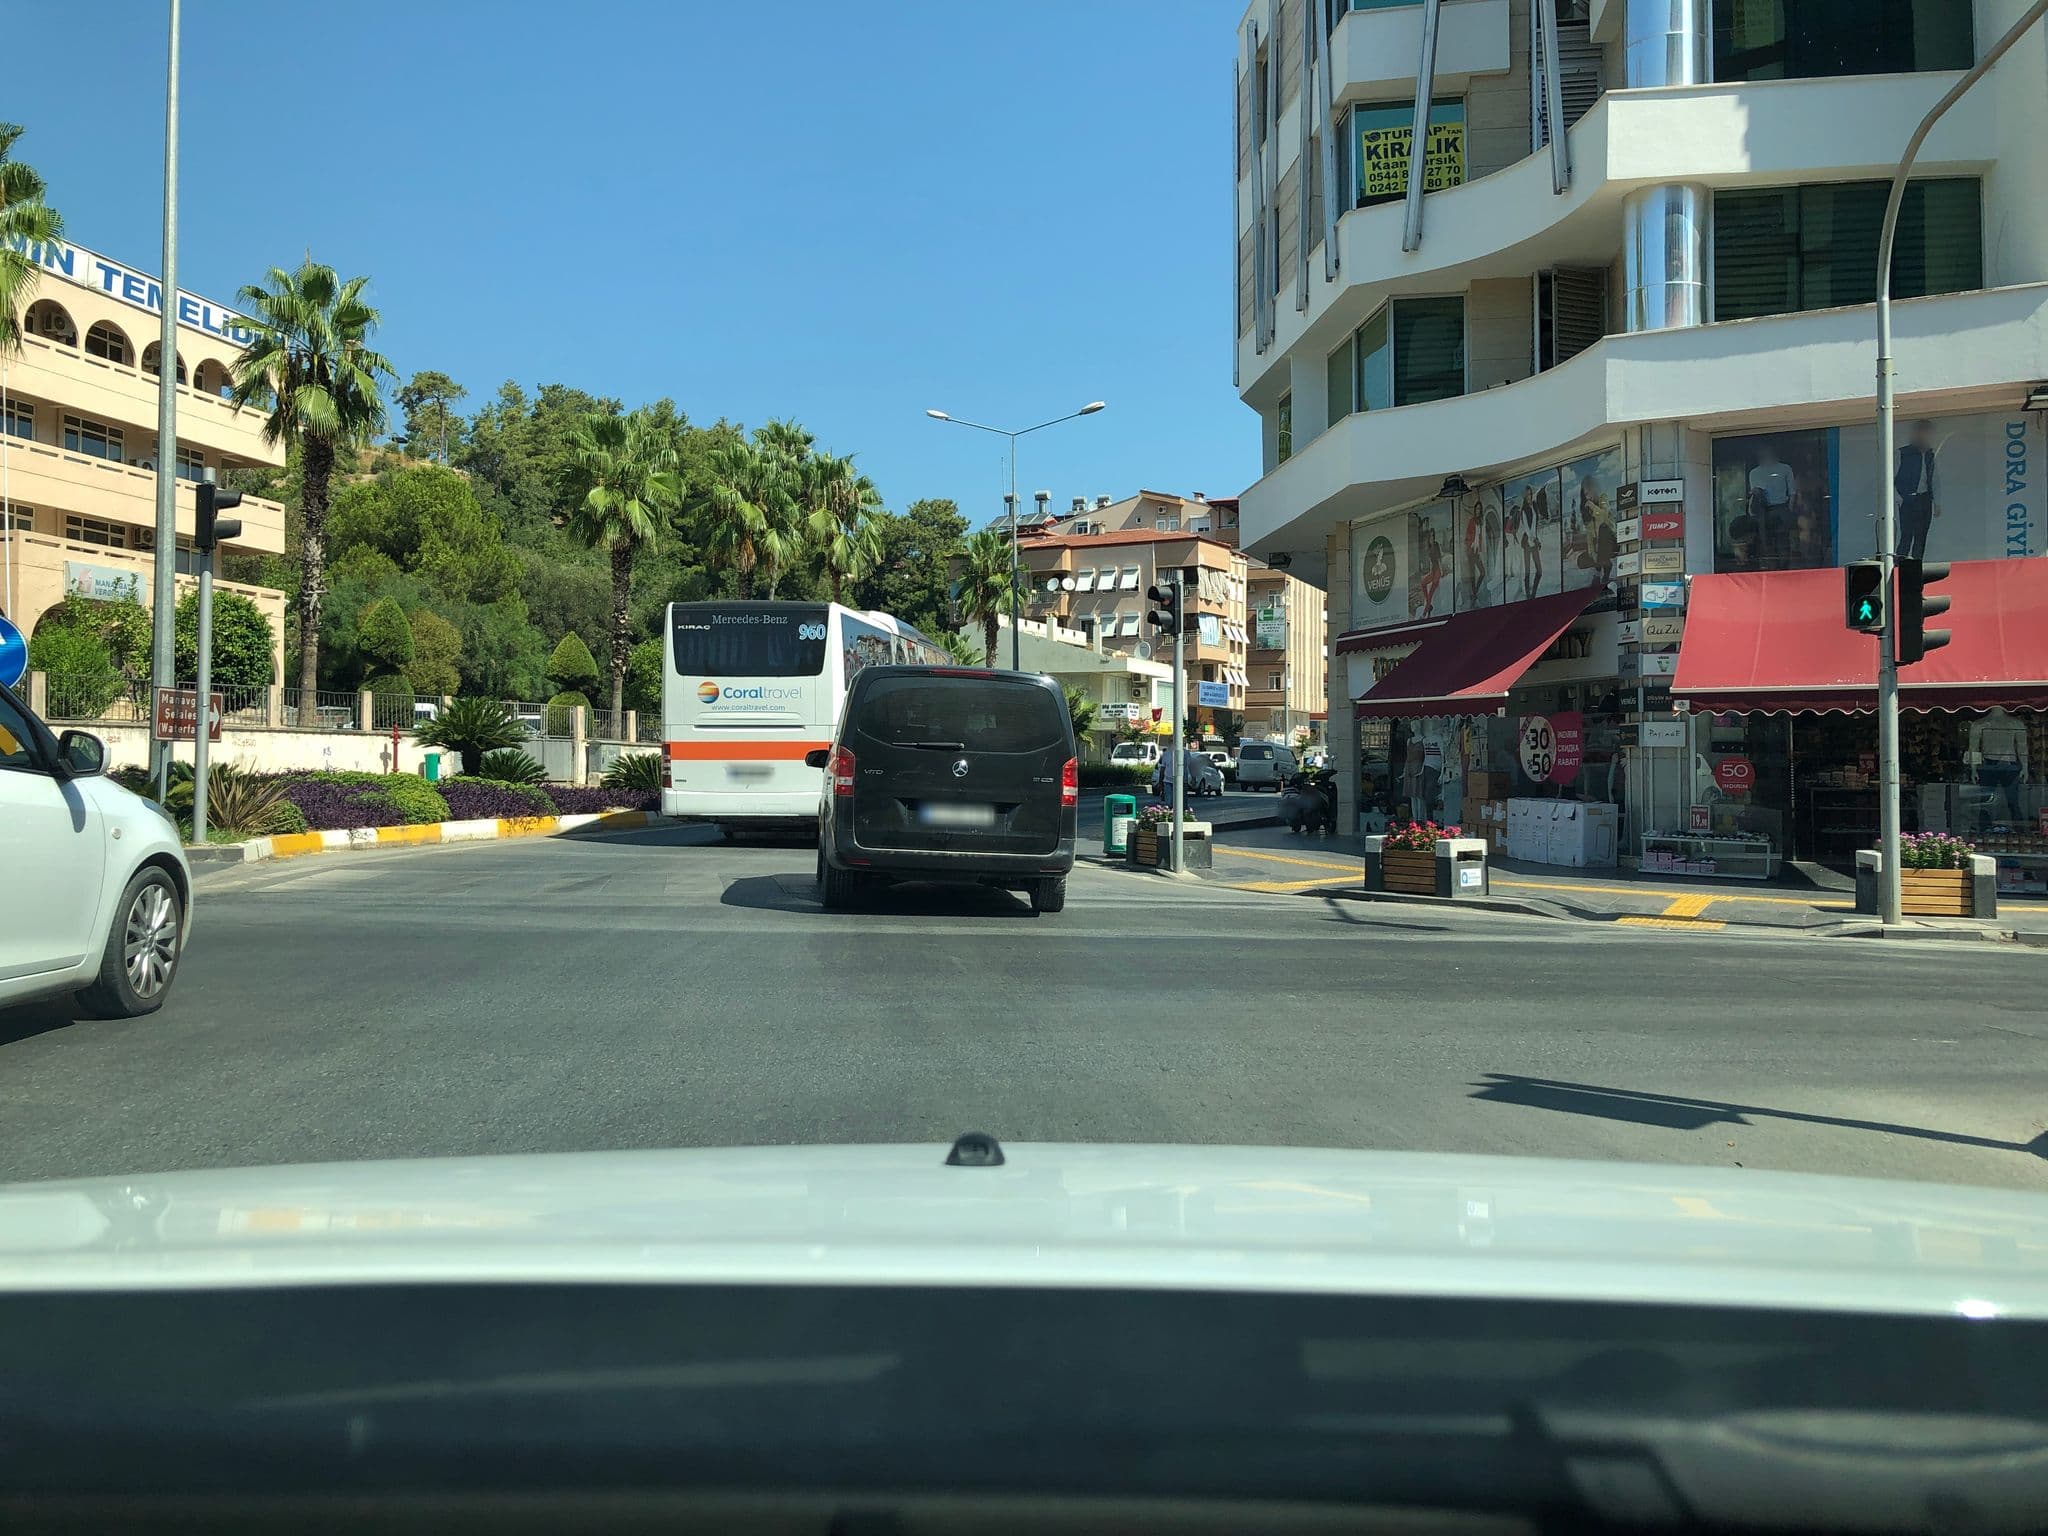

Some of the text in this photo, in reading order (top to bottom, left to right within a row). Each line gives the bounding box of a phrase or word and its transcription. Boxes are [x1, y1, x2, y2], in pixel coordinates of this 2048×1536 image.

[1371, 160, 1407, 171] Kaan
[1369, 171, 1399, 182] 0544
[1427, 167, 1442, 176] 27
[1446, 165, 1461, 175] 70
[1369, 181, 1399, 193] 0242
[1427, 178, 1442, 188] 80
[1446, 176, 1461, 187] 18
[2006, 421, 2034, 557] DORA GİYİ
[712, 614, 788, 625] Mercedes-Benz
[799, 624, 826, 640] 960
[161, 693, 196, 708] Manavg
[165, 708, 197, 720] Şelales
[712, 703, 786, 712] www.coraltravel.com
[158, 722, 196, 735] (Waterfa
[1557, 758, 1579, 766] RABATT
[1722, 764, 1748, 777] 50
